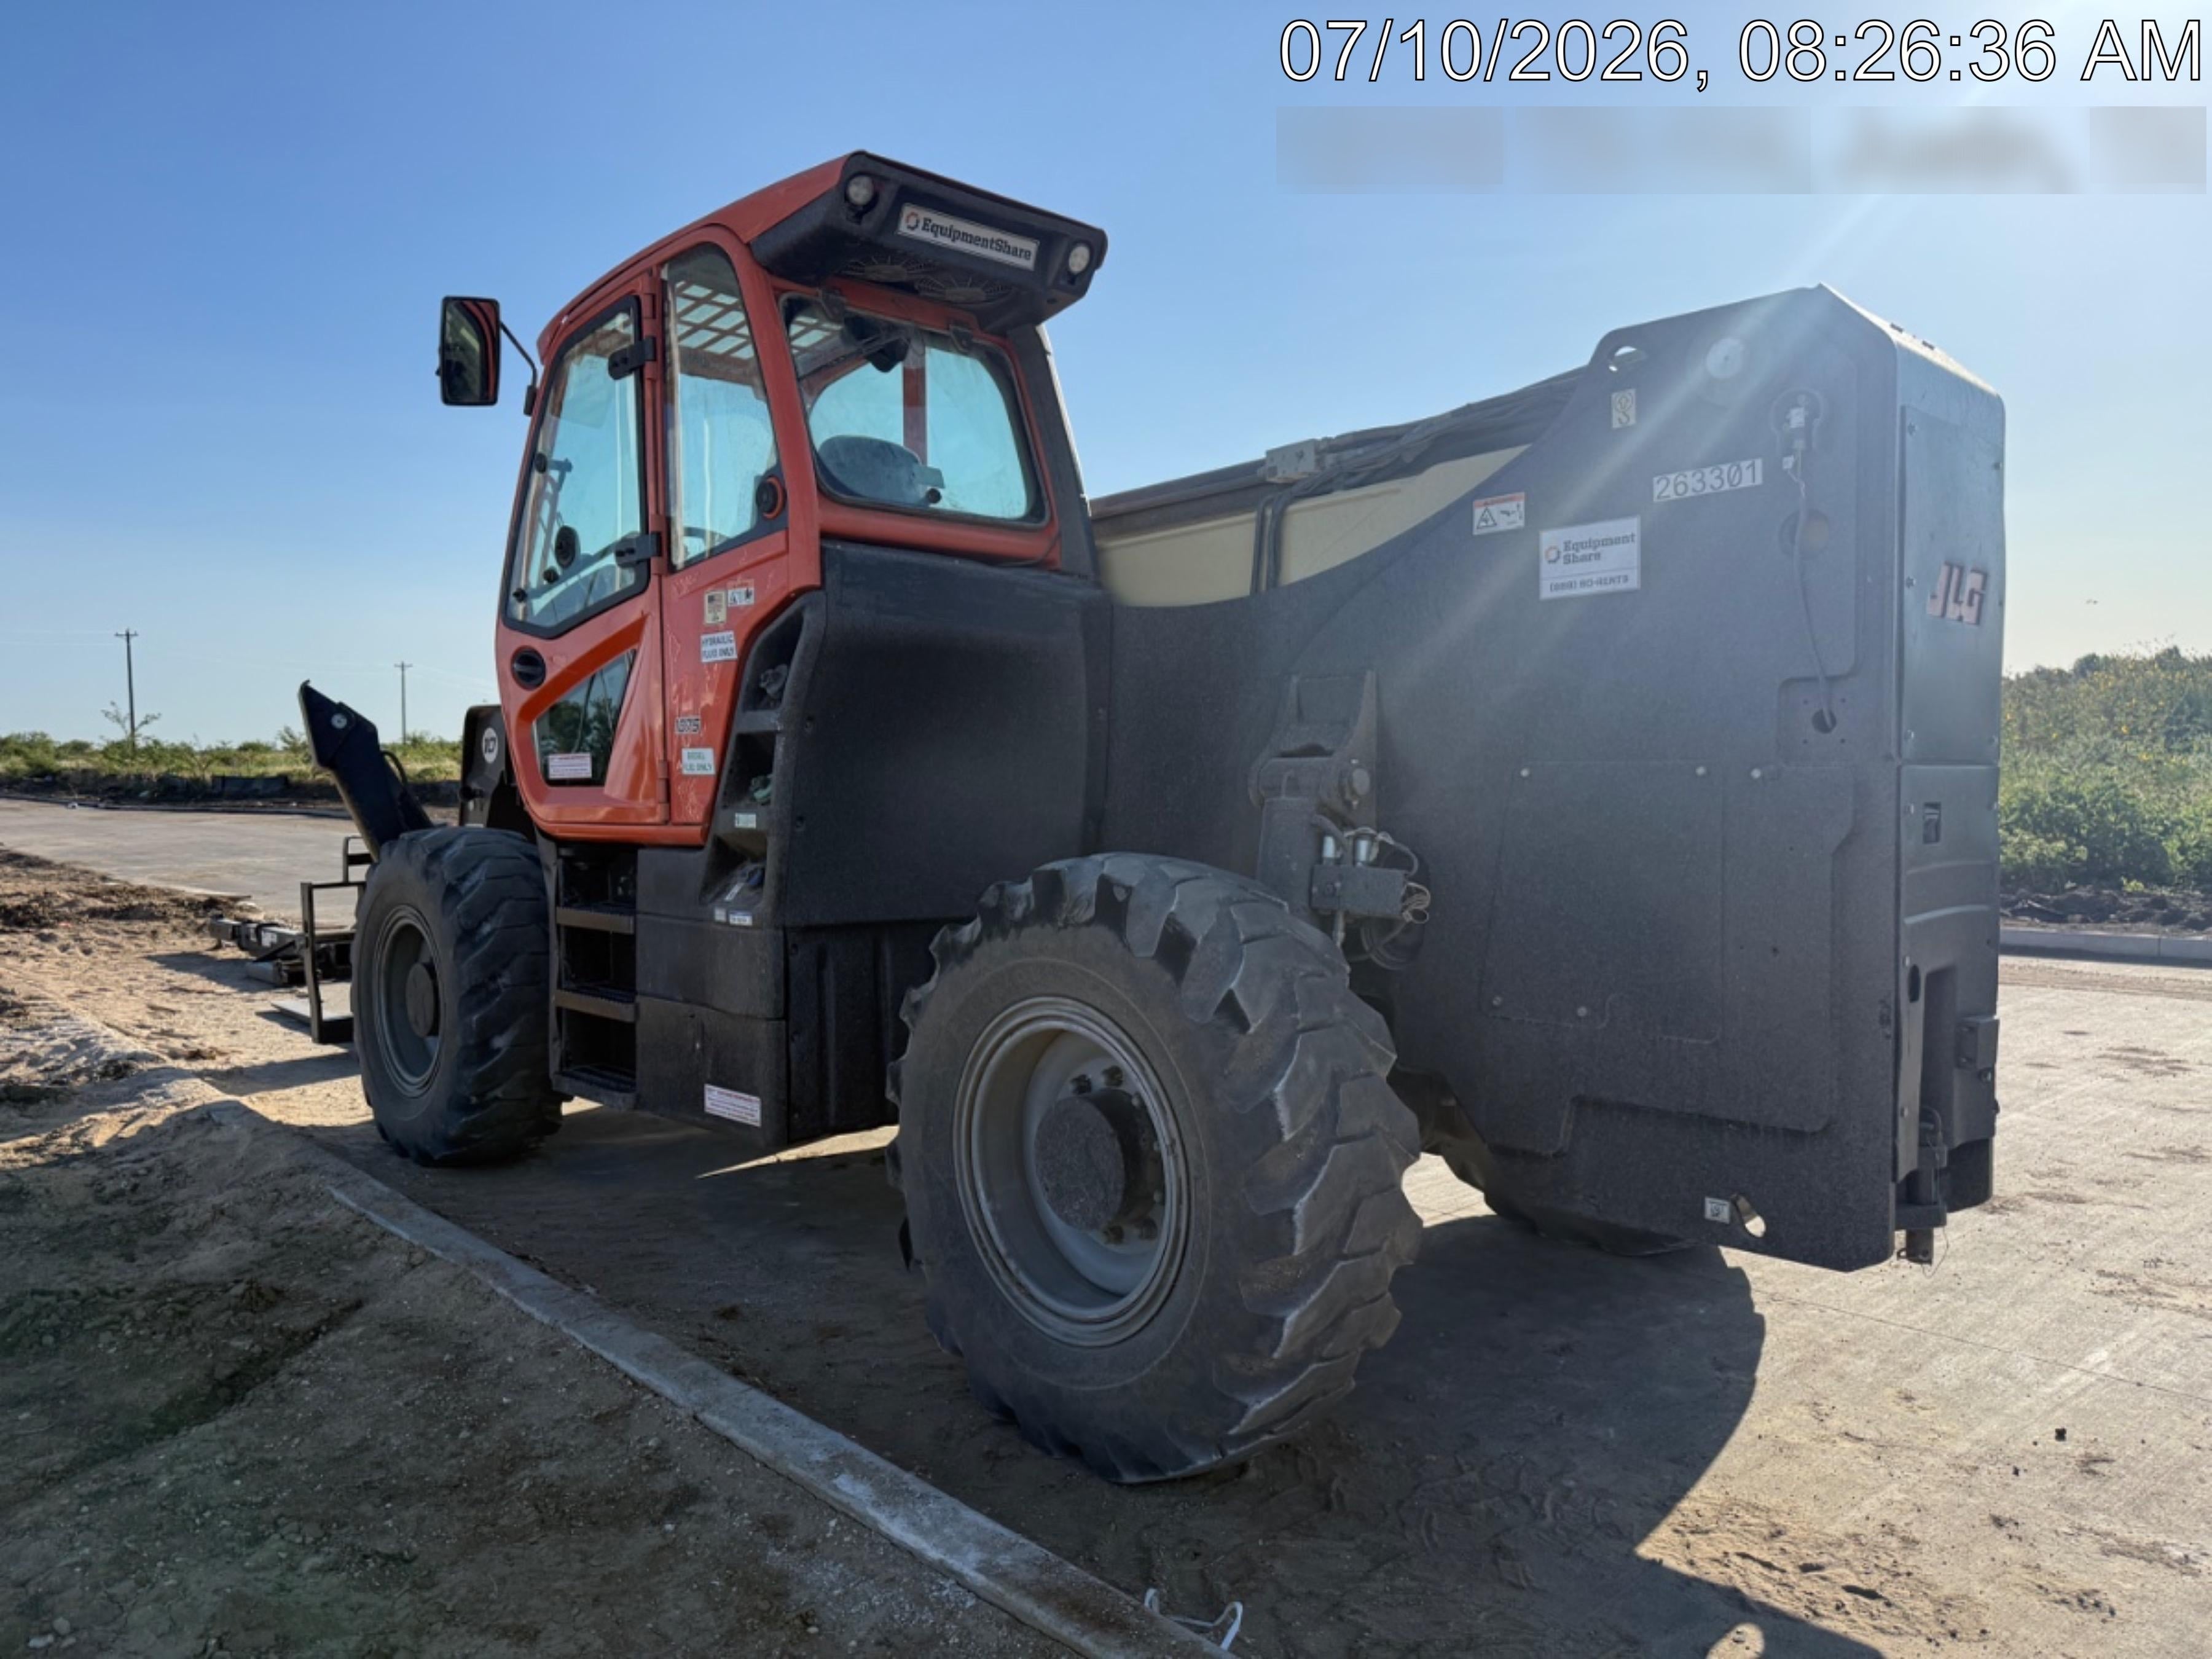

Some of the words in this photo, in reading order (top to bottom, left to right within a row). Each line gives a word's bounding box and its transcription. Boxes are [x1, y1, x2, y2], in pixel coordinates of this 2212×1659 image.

[922, 217, 1032, 261] EquipmentShare
[1657, 460, 1755, 500] 263301
[1563, 532, 1636, 552] Equipment
[1563, 552, 1601, 565] Share
[1927, 560, 1988, 626] JLG
